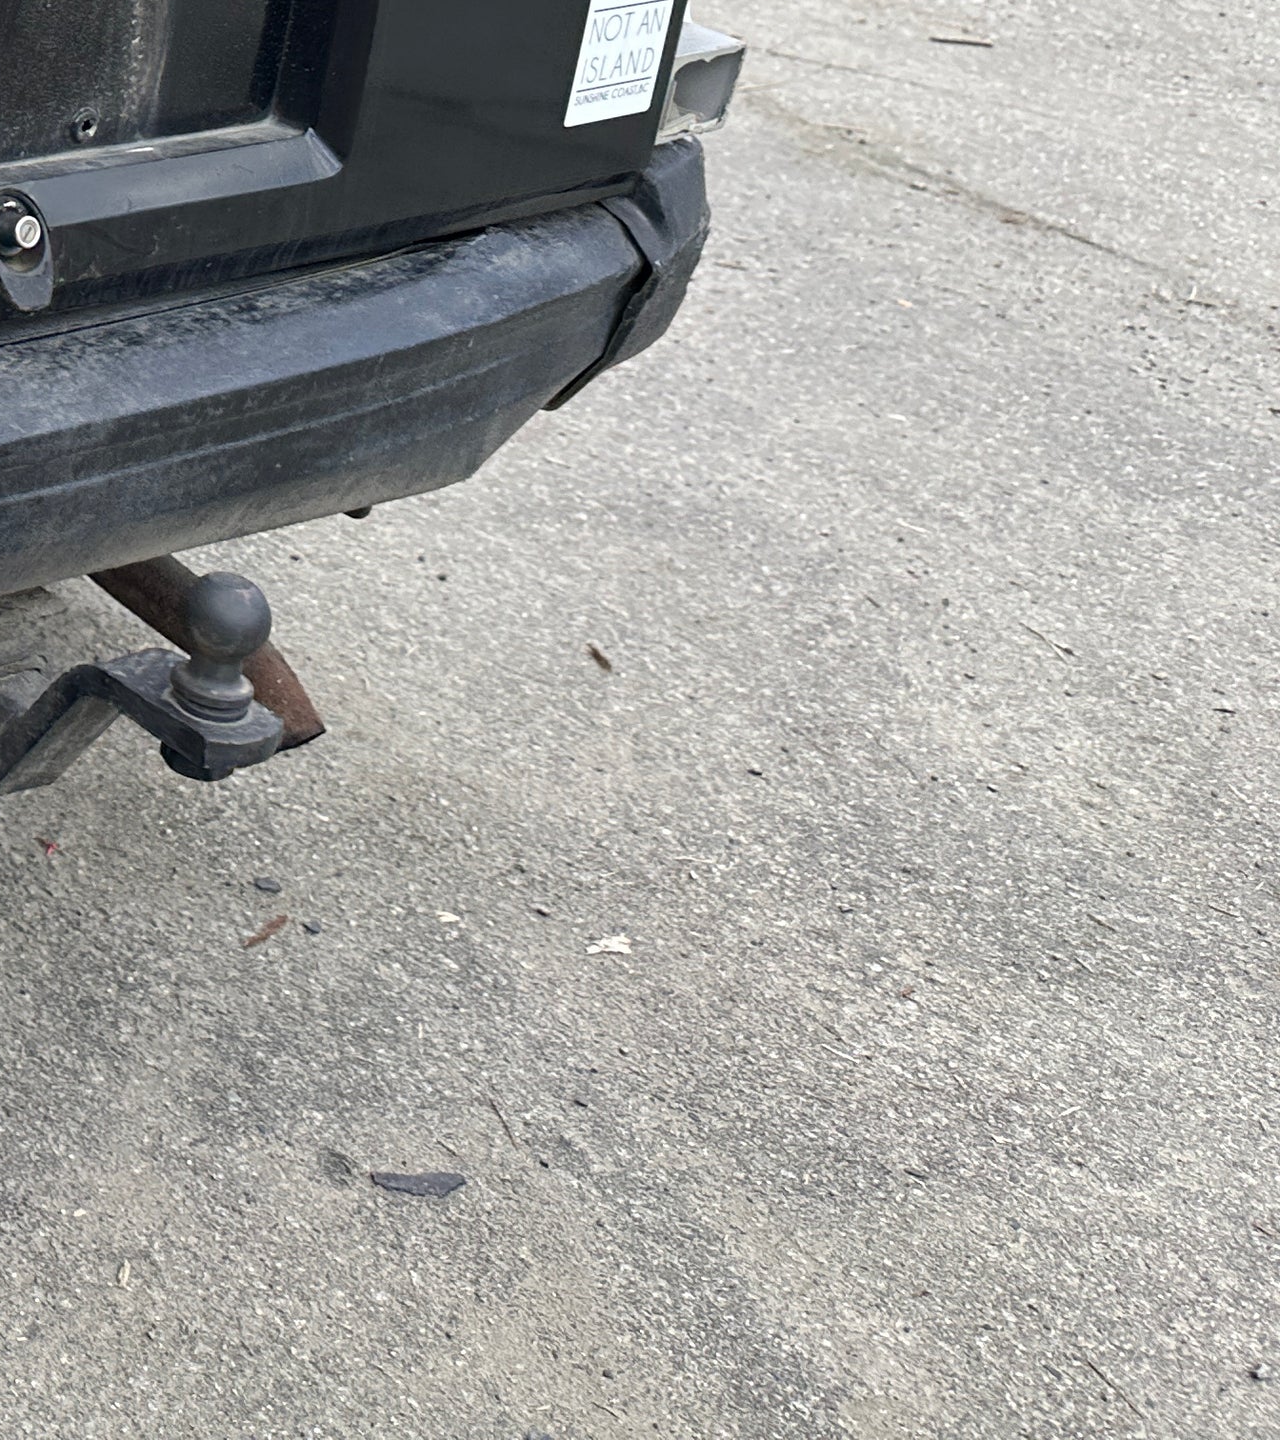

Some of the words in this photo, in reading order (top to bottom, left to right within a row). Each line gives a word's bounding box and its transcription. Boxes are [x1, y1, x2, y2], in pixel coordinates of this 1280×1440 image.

[589, 12, 636, 45] NOT
[637, 6, 666, 35] AN
[580, 47, 656, 85] ISLAND
